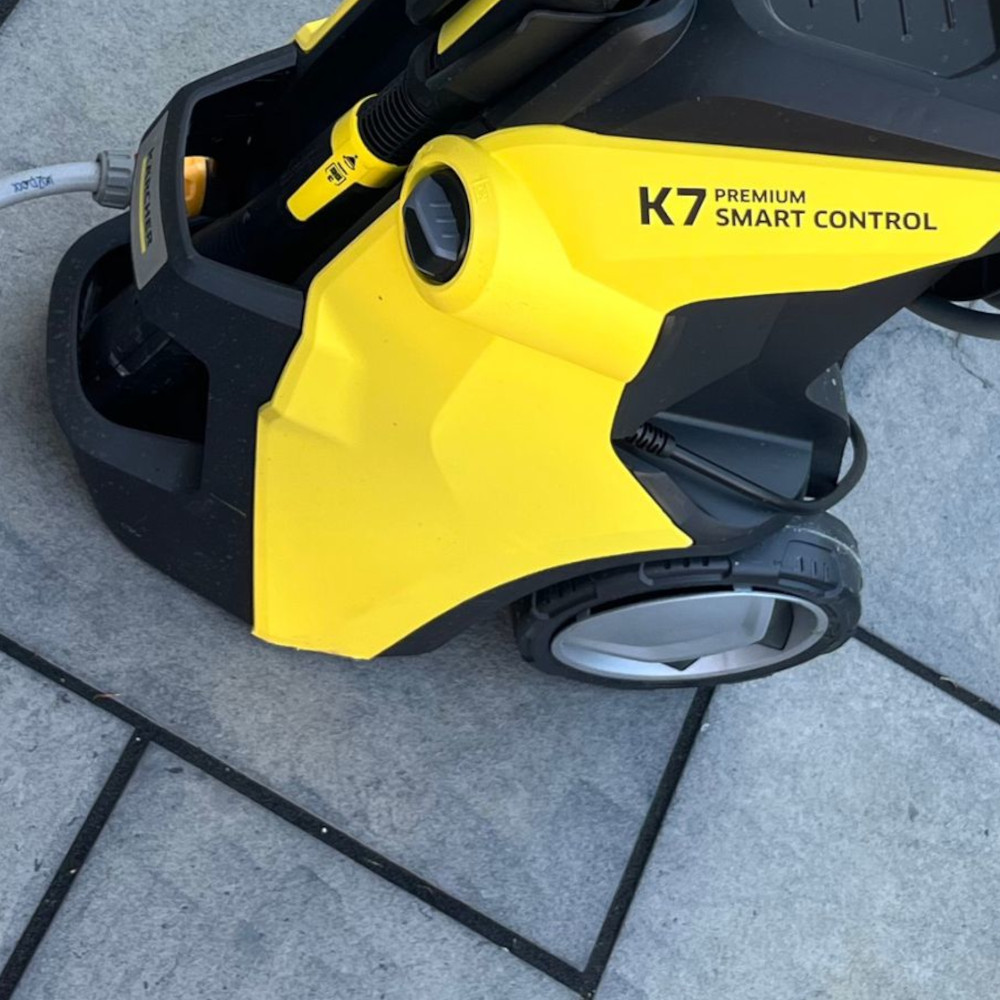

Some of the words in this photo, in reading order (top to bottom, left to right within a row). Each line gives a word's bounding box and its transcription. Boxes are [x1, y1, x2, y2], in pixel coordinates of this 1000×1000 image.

[638, 186, 707, 226] K7
[715, 188, 806, 204] PREMIUM
[716, 208, 805, 228] SMART
[813, 209, 938, 231] CONTROL
